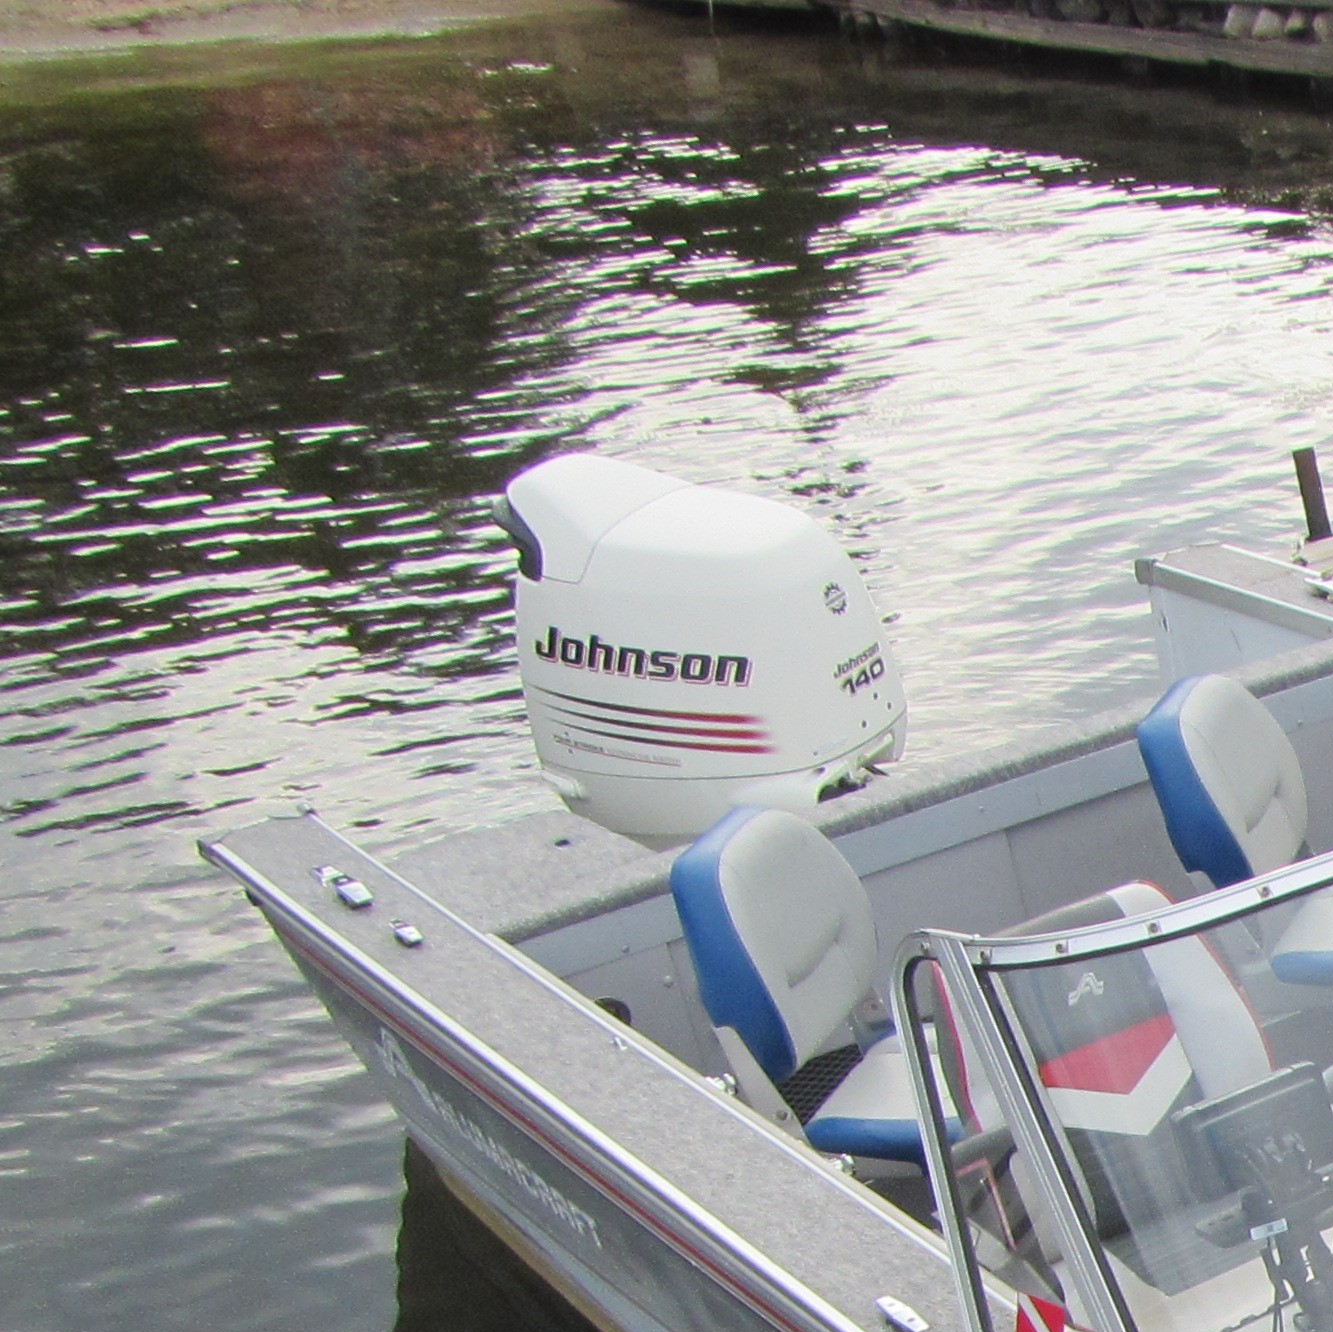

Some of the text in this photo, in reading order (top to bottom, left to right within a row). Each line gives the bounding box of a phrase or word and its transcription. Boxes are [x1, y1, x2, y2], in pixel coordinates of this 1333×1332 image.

[534, 625, 752, 687] Johnson
[832, 641, 880, 680] Johnson
[841, 656, 885, 695] 140
